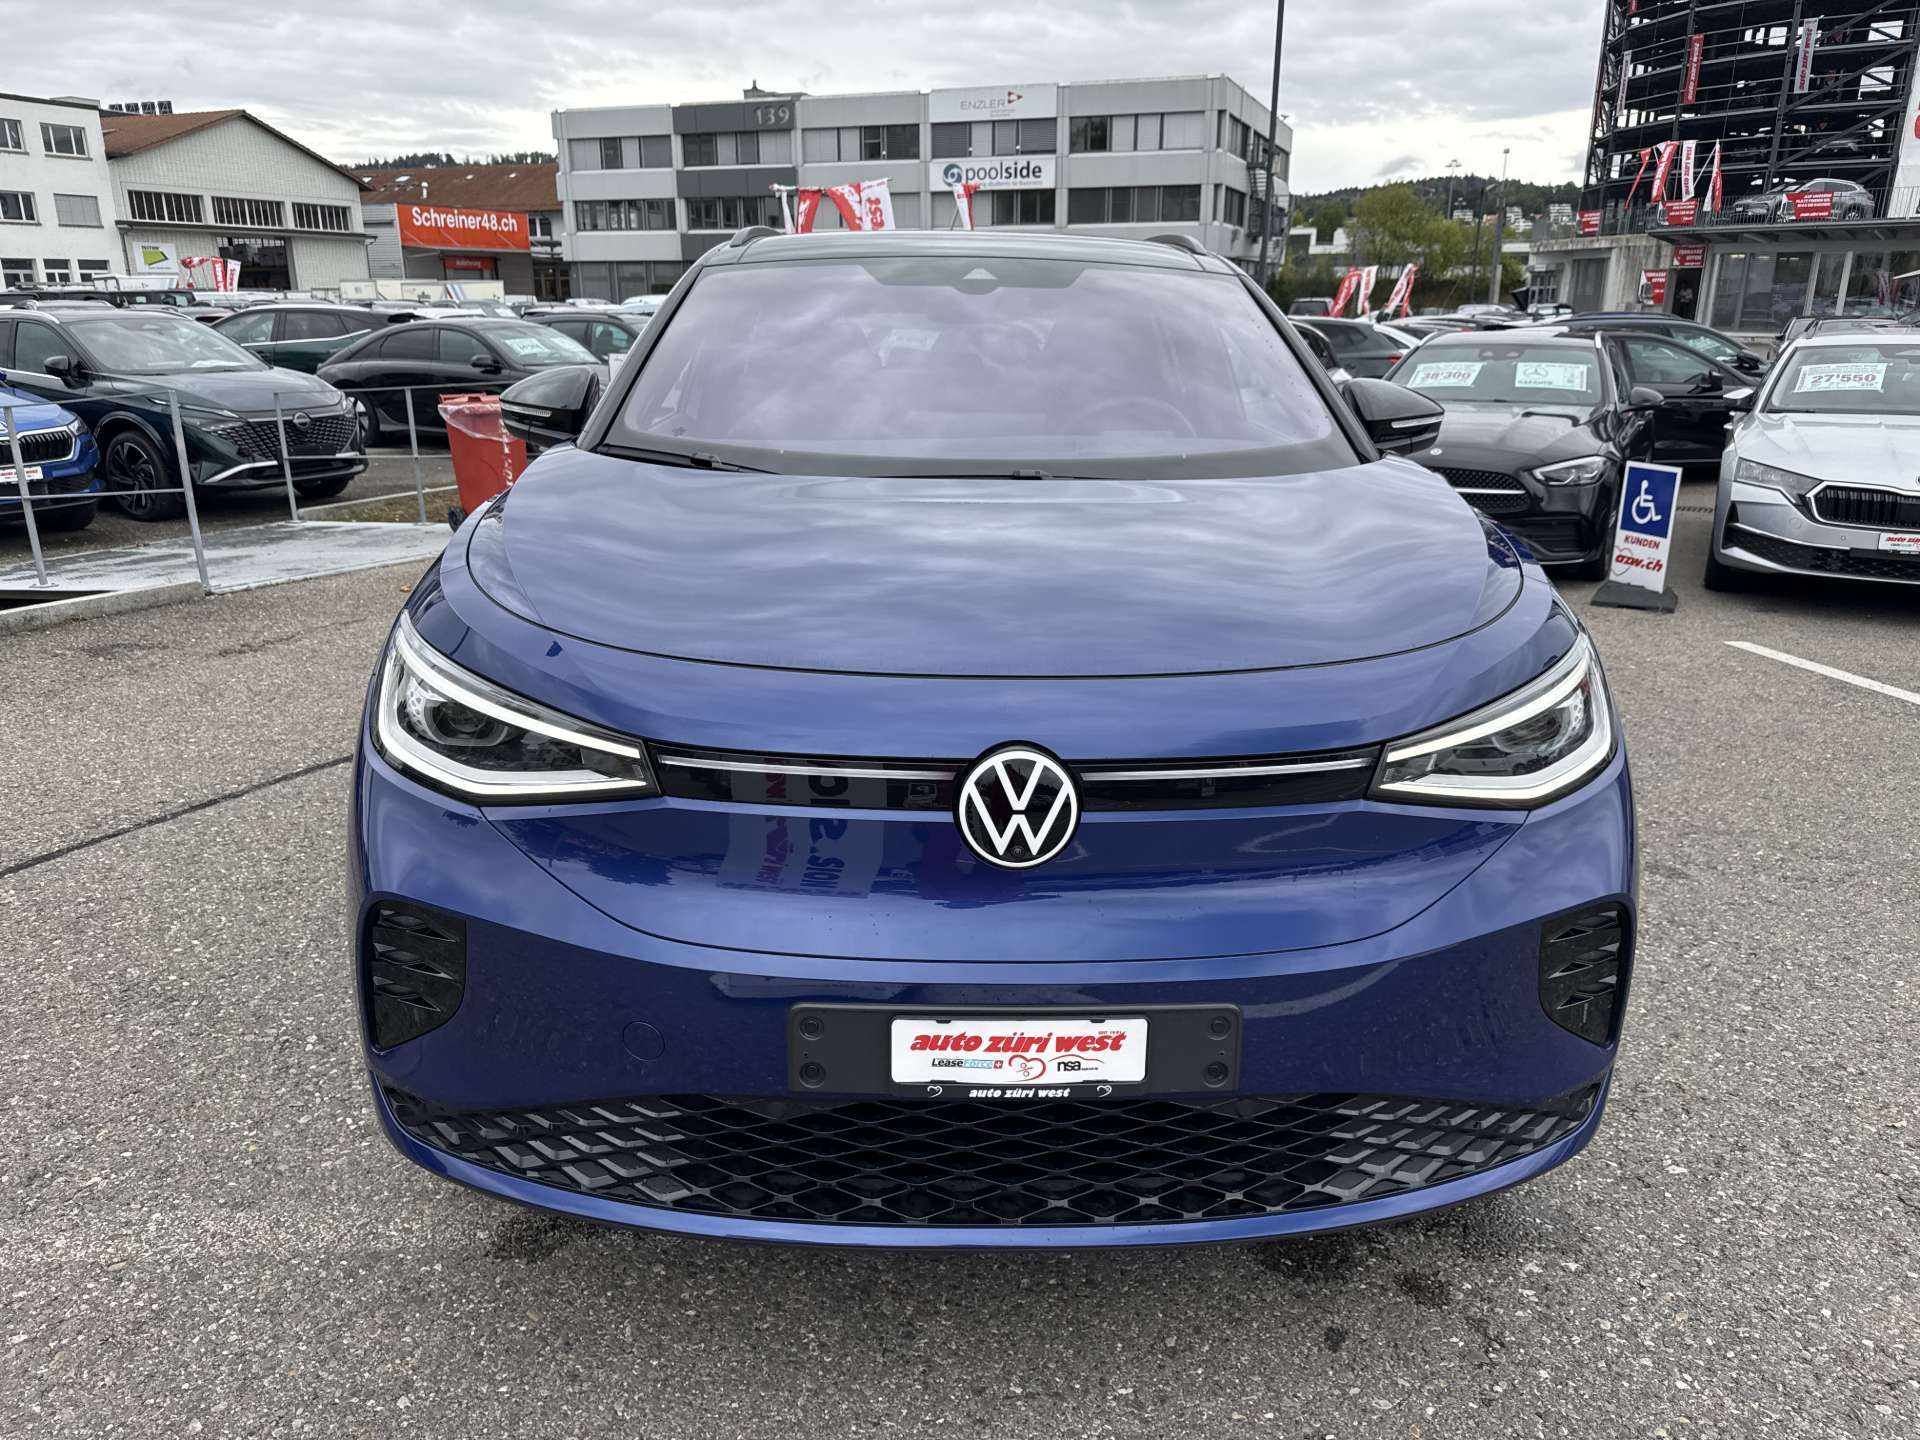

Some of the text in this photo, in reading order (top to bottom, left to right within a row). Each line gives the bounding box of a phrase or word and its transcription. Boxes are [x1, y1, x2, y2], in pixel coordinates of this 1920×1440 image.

[960, 99, 1005, 110] ENZLER
[757, 107, 790, 125] 139
[965, 160, 1042, 183] poolside
[412, 206, 518, 232] Schreiner48.ch
[869, 196, 886, 229] est
[1811, 374, 1877, 384] 27'550
[1624, 535, 1660, 550] KUNDEN
[1615, 554, 1663, 572] azw.ch
[962, 753, 1075, 864] VW
[910, 1031, 1127, 1053] auto züri west
[1057, 1060, 1081, 1072] nsa
[969, 1087, 1071, 1098] auto züri west
